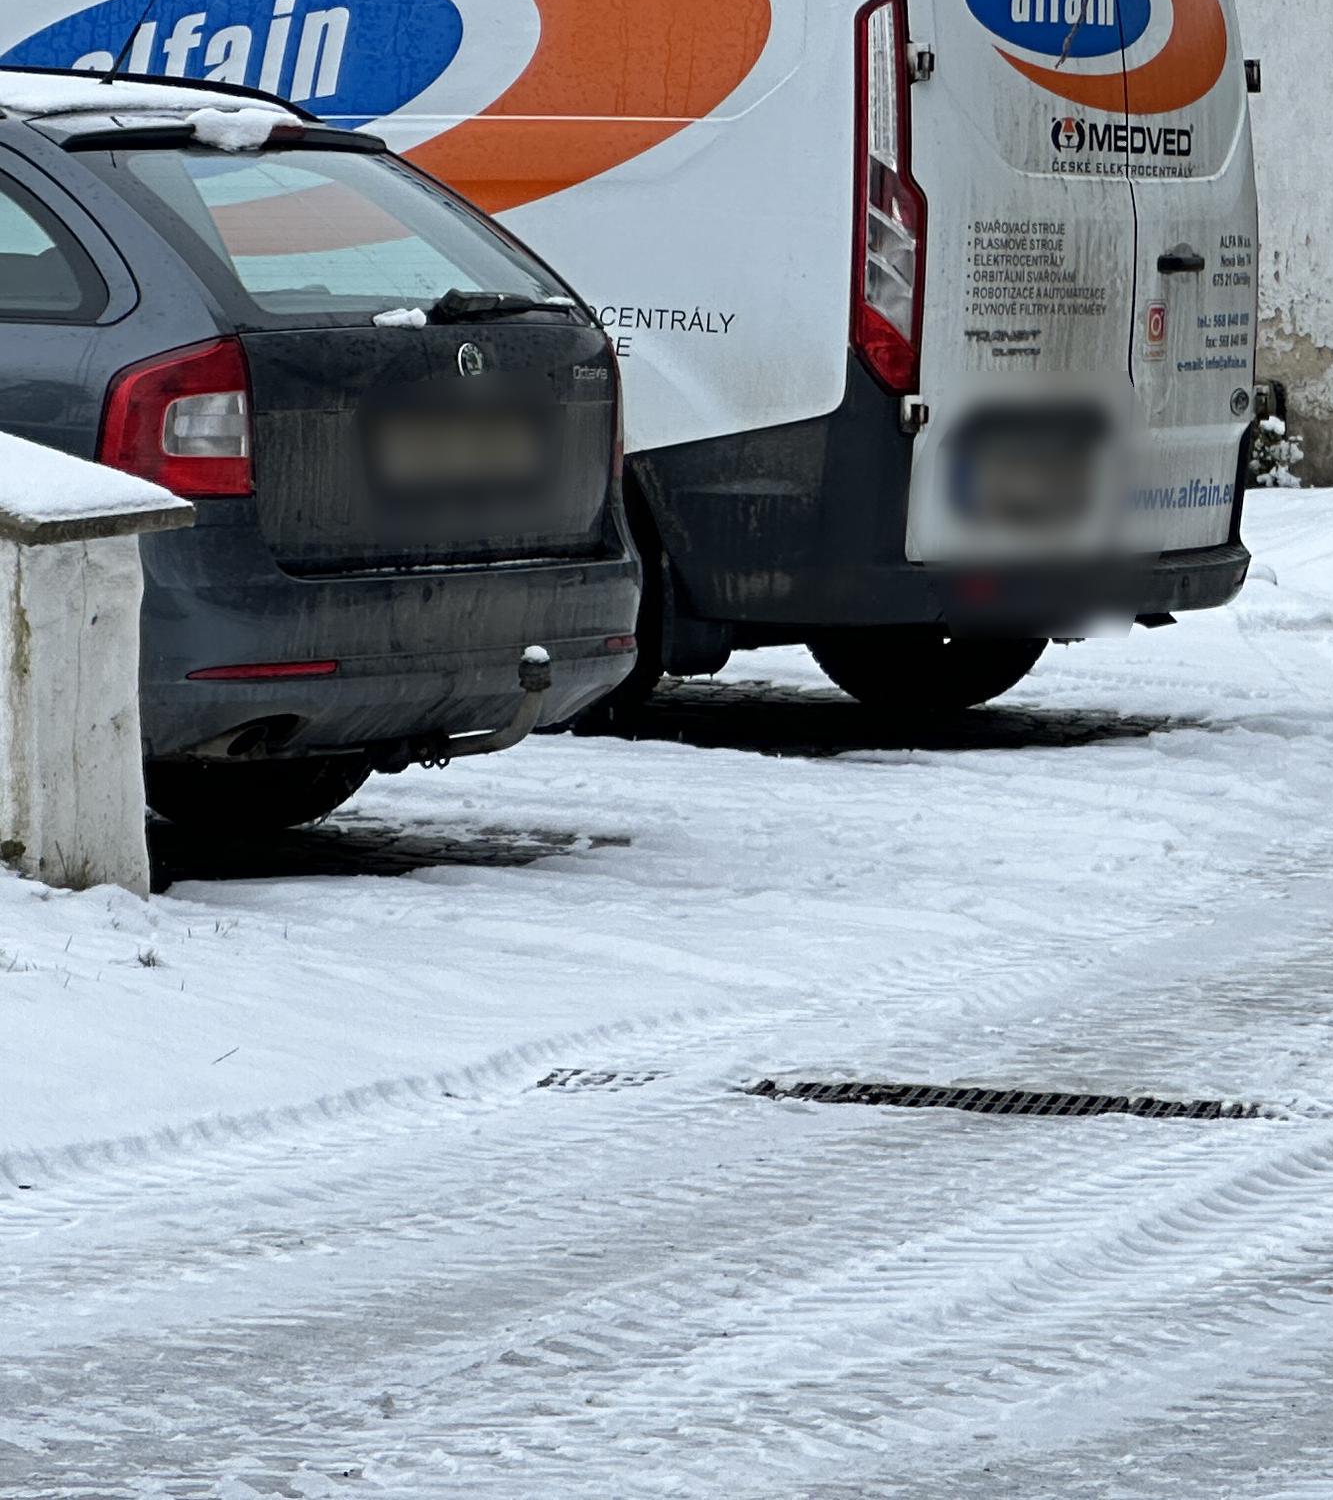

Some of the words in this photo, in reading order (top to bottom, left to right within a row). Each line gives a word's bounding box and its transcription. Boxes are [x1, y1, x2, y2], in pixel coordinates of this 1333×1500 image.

[1088, 122, 1192, 157] MEDVED
[1051, 157, 1092, 174] ČESKÉ
[1096, 162, 1194, 179] ELEKTROCENTRÁLY
[974, 220, 1031, 235] SVAŘOVACÍ
[1031, 224, 1066, 236] STROJE
[974, 237, 1028, 251] PLASMOVÉ
[1029, 240, 1064, 252] STROJE
[1220, 236, 1236, 249] ALFA
[973, 253, 1066, 267] ELEKTROCENTRÁLY
[973, 269, 1025, 283] ORBITÁLNÍ
[972, 287, 1034, 300] ROBOTIZACE
[1043, 288, 1106, 300] AUTOMATIZACE
[971, 302, 1017, 316] PLYNOVÉ
[1019, 304, 1049, 316] FILTRY
